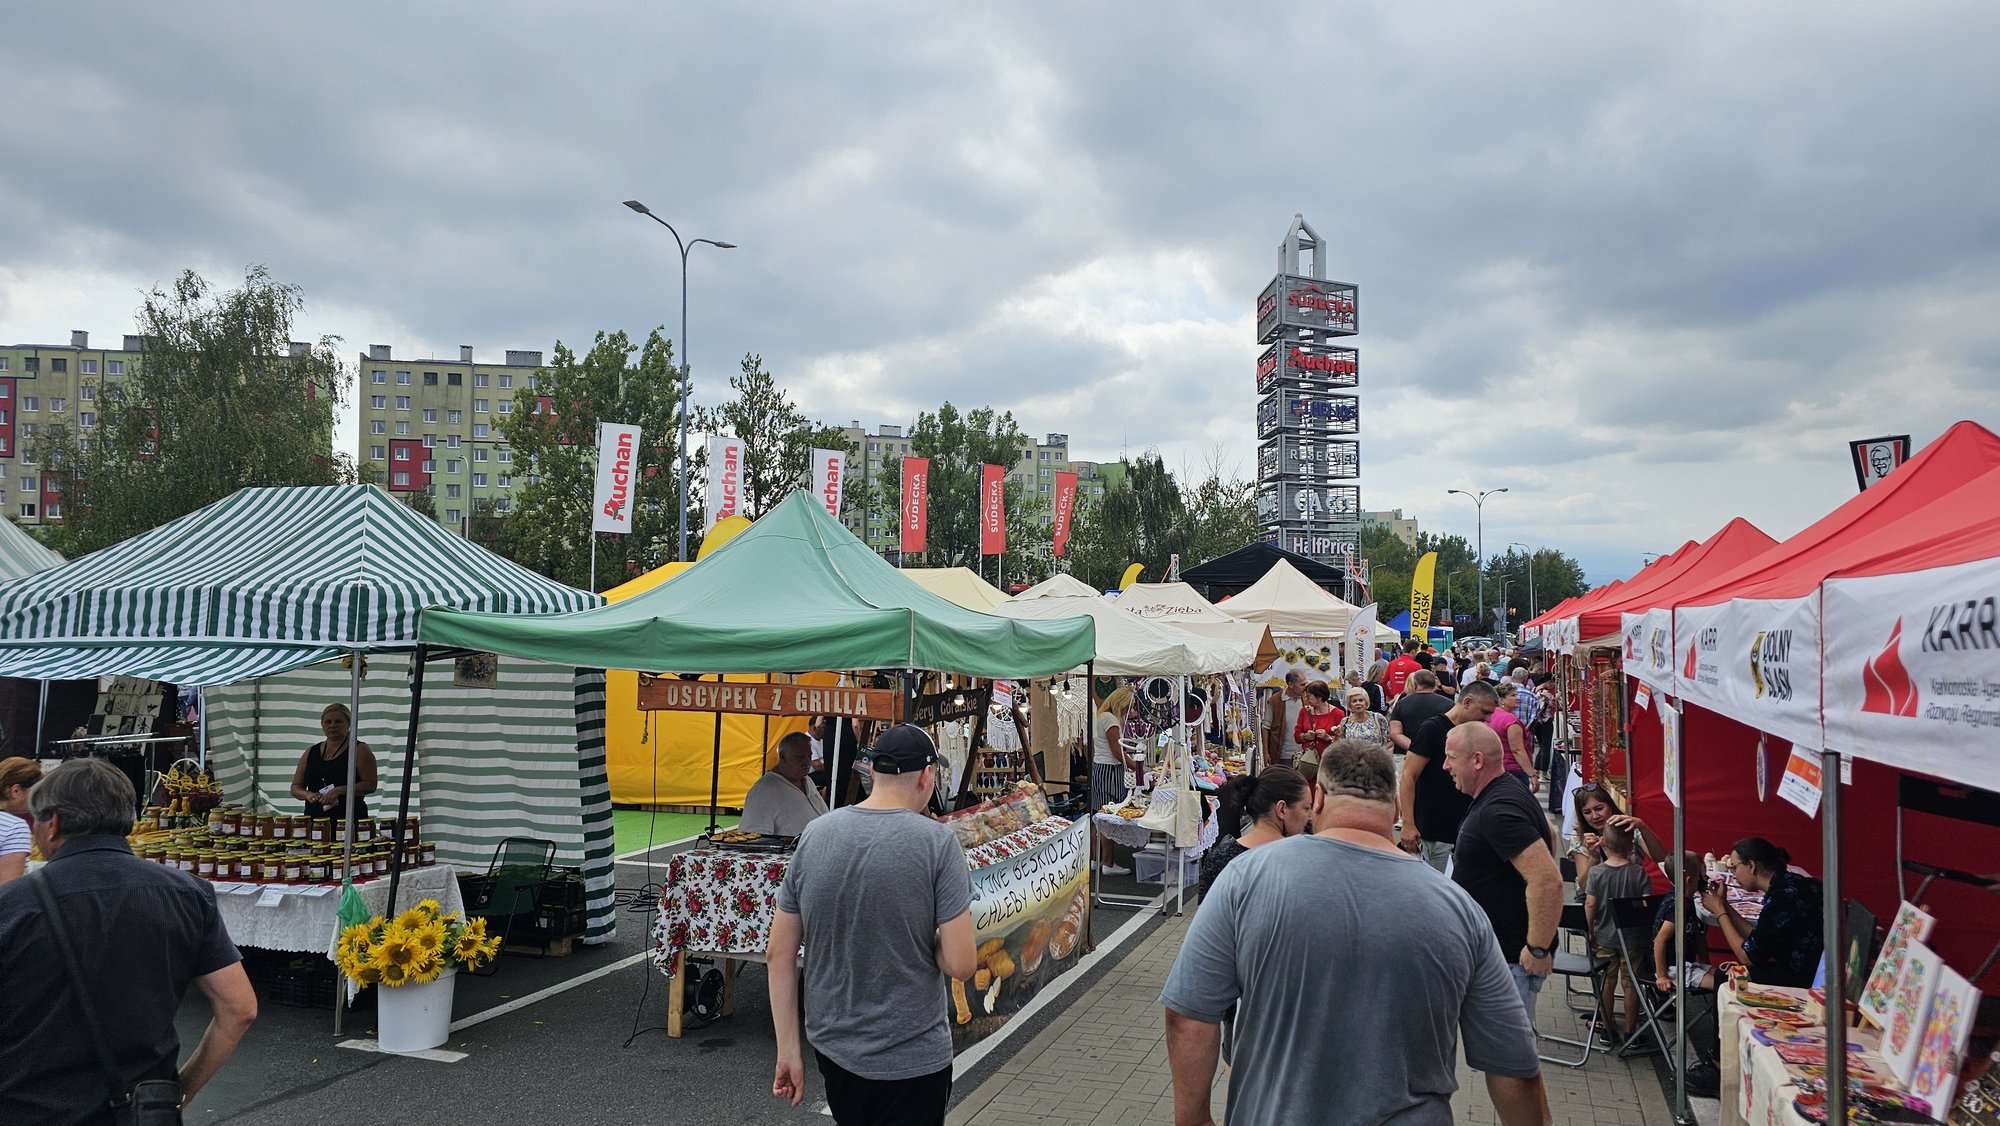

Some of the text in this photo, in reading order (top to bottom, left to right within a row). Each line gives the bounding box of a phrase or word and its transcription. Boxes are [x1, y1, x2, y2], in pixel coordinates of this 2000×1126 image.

[1289, 291, 1355, 314] SUDECKA
[1287, 348, 1356, 374] Auchan
[603, 432, 632, 521] Auchan
[1290, 449, 1358, 465] RESERVED
[824, 457, 839, 517] uchan
[911, 473, 920, 530] SUDECKA
[991, 480, 999, 533] SUDECKA
[1055, 486, 1070, 537] SUDECKA
[1412, 589, 1421, 628] DOLNY
[1922, 595, 2000, 652] KARR
[1762, 630, 1792, 663] DOLNY
[667, 685, 868, 716] OSCYPEK Z GRILLA
[976, 887, 1029, 931] CHLEBY
